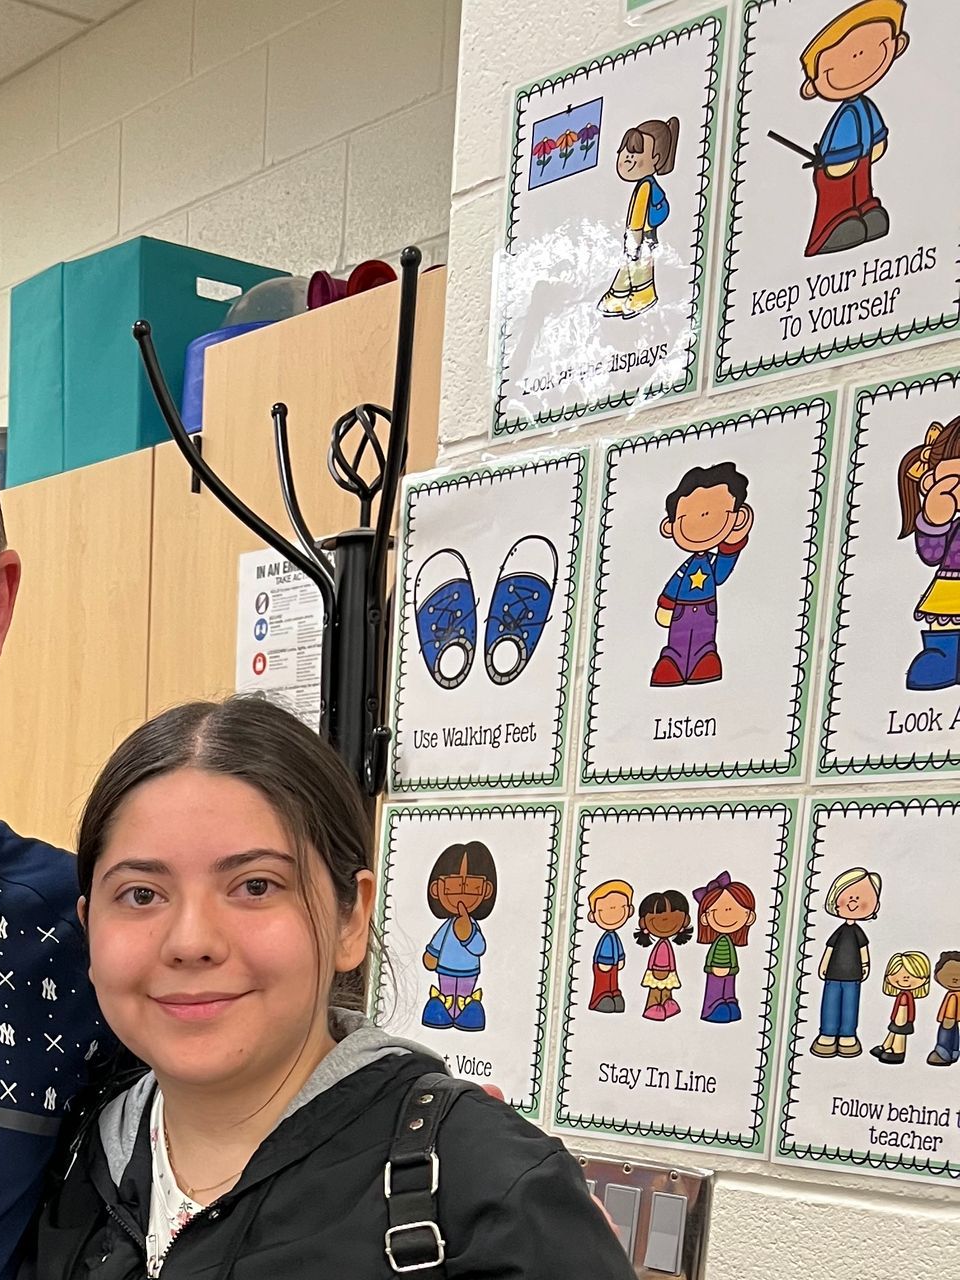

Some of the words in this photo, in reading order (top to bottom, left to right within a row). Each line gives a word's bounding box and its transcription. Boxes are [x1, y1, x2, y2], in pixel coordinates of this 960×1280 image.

[751, 284, 800, 316] Keep
[806, 269, 856, 301] Your
[861, 246, 936, 287] Hands
[779, 314, 802, 341] To
[808, 286, 900, 334] Yourself
[413, 730, 438, 749] Use
[442, 724, 502, 748] Walking
[504, 721, 537, 744] Feet
[653, 717, 717, 740] Listen
[886, 707, 943, 735] Look
[456, 1054, 493, 1077] Voice
[598, 1063, 642, 1090] Stay
[645, 1066, 670, 1088] In
[675, 1069, 717, 1093] Line
[831, 1097, 884, 1120] Follow
[886, 1102, 950, 1127] behind
[868, 1125, 943, 1152] teacher
